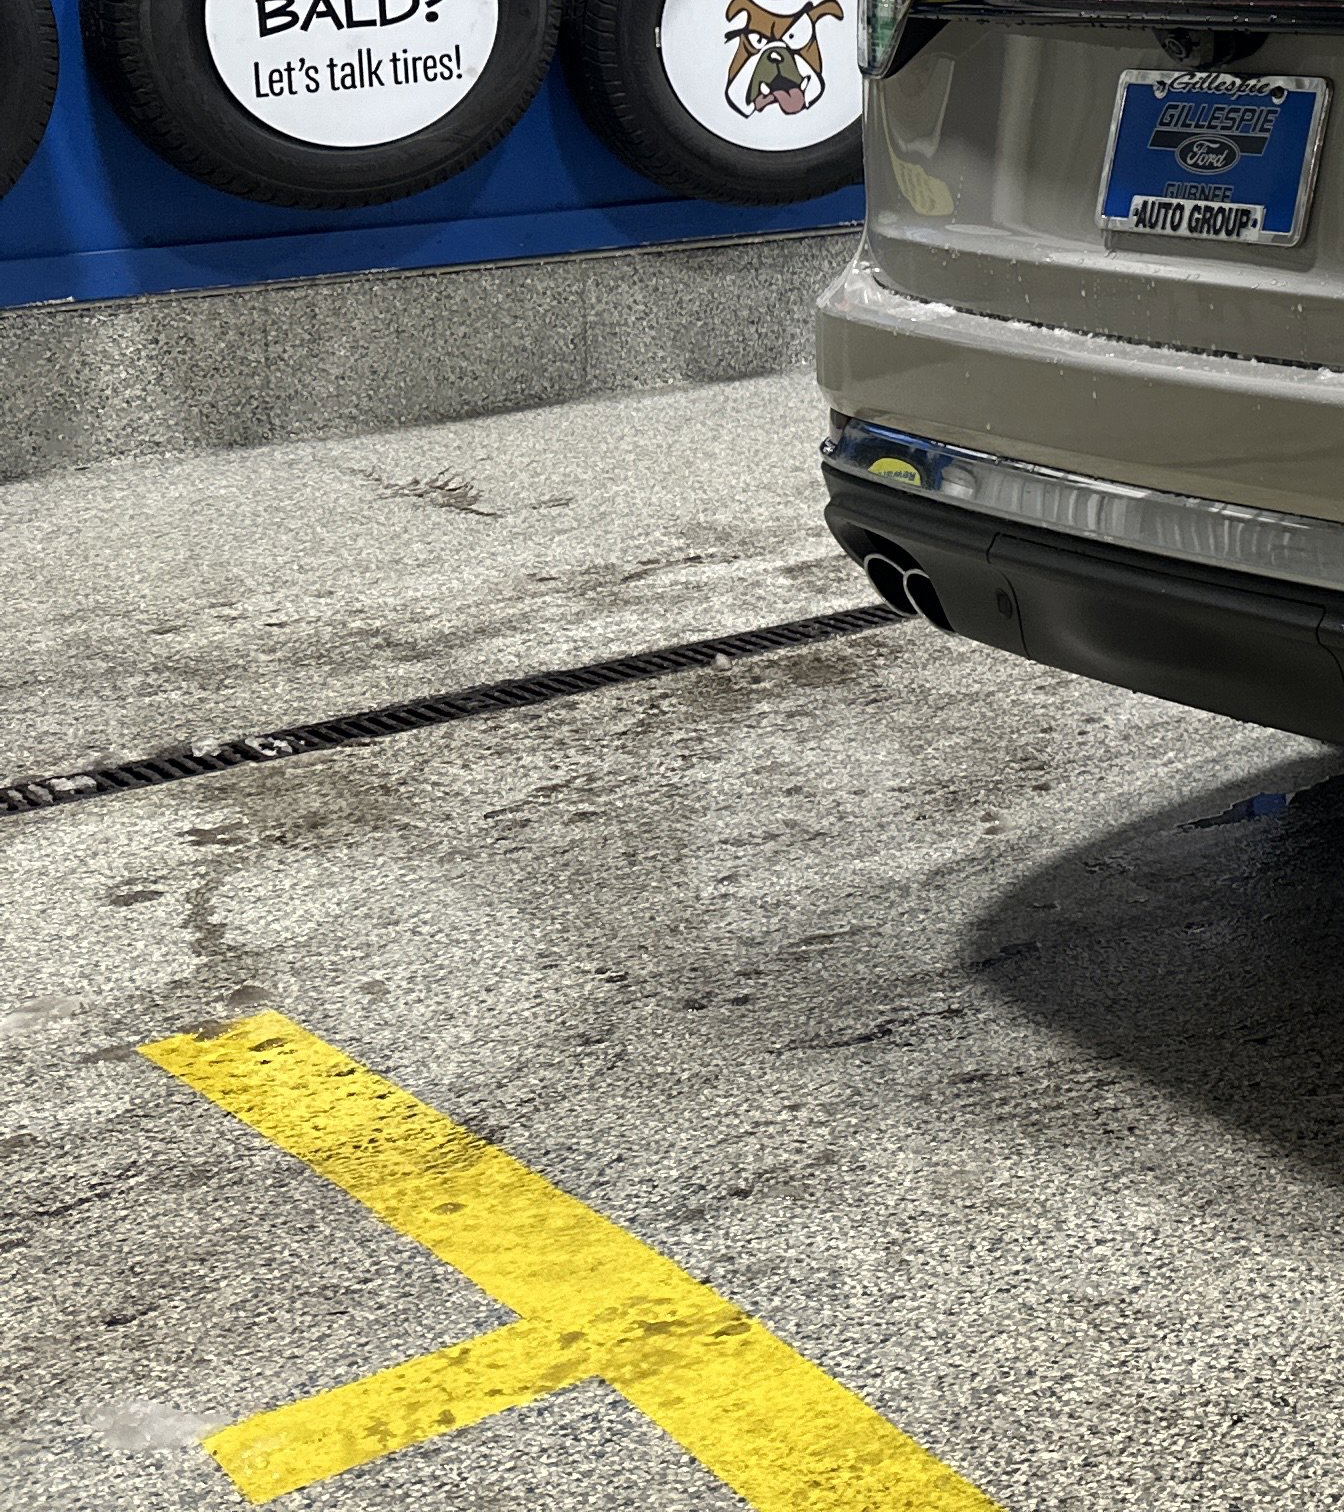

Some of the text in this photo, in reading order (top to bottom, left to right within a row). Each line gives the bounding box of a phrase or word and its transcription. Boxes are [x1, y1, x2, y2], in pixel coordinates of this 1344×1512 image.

[253, 44, 464, 99] Let's talk tires!
[1168, 72, 1270, 100] Gillespie
[1156, 101, 1281, 135] GILLESPIE
[1186, 140, 1228, 169] Ford
[1134, 200, 1252, 238] AUTO GROUP
